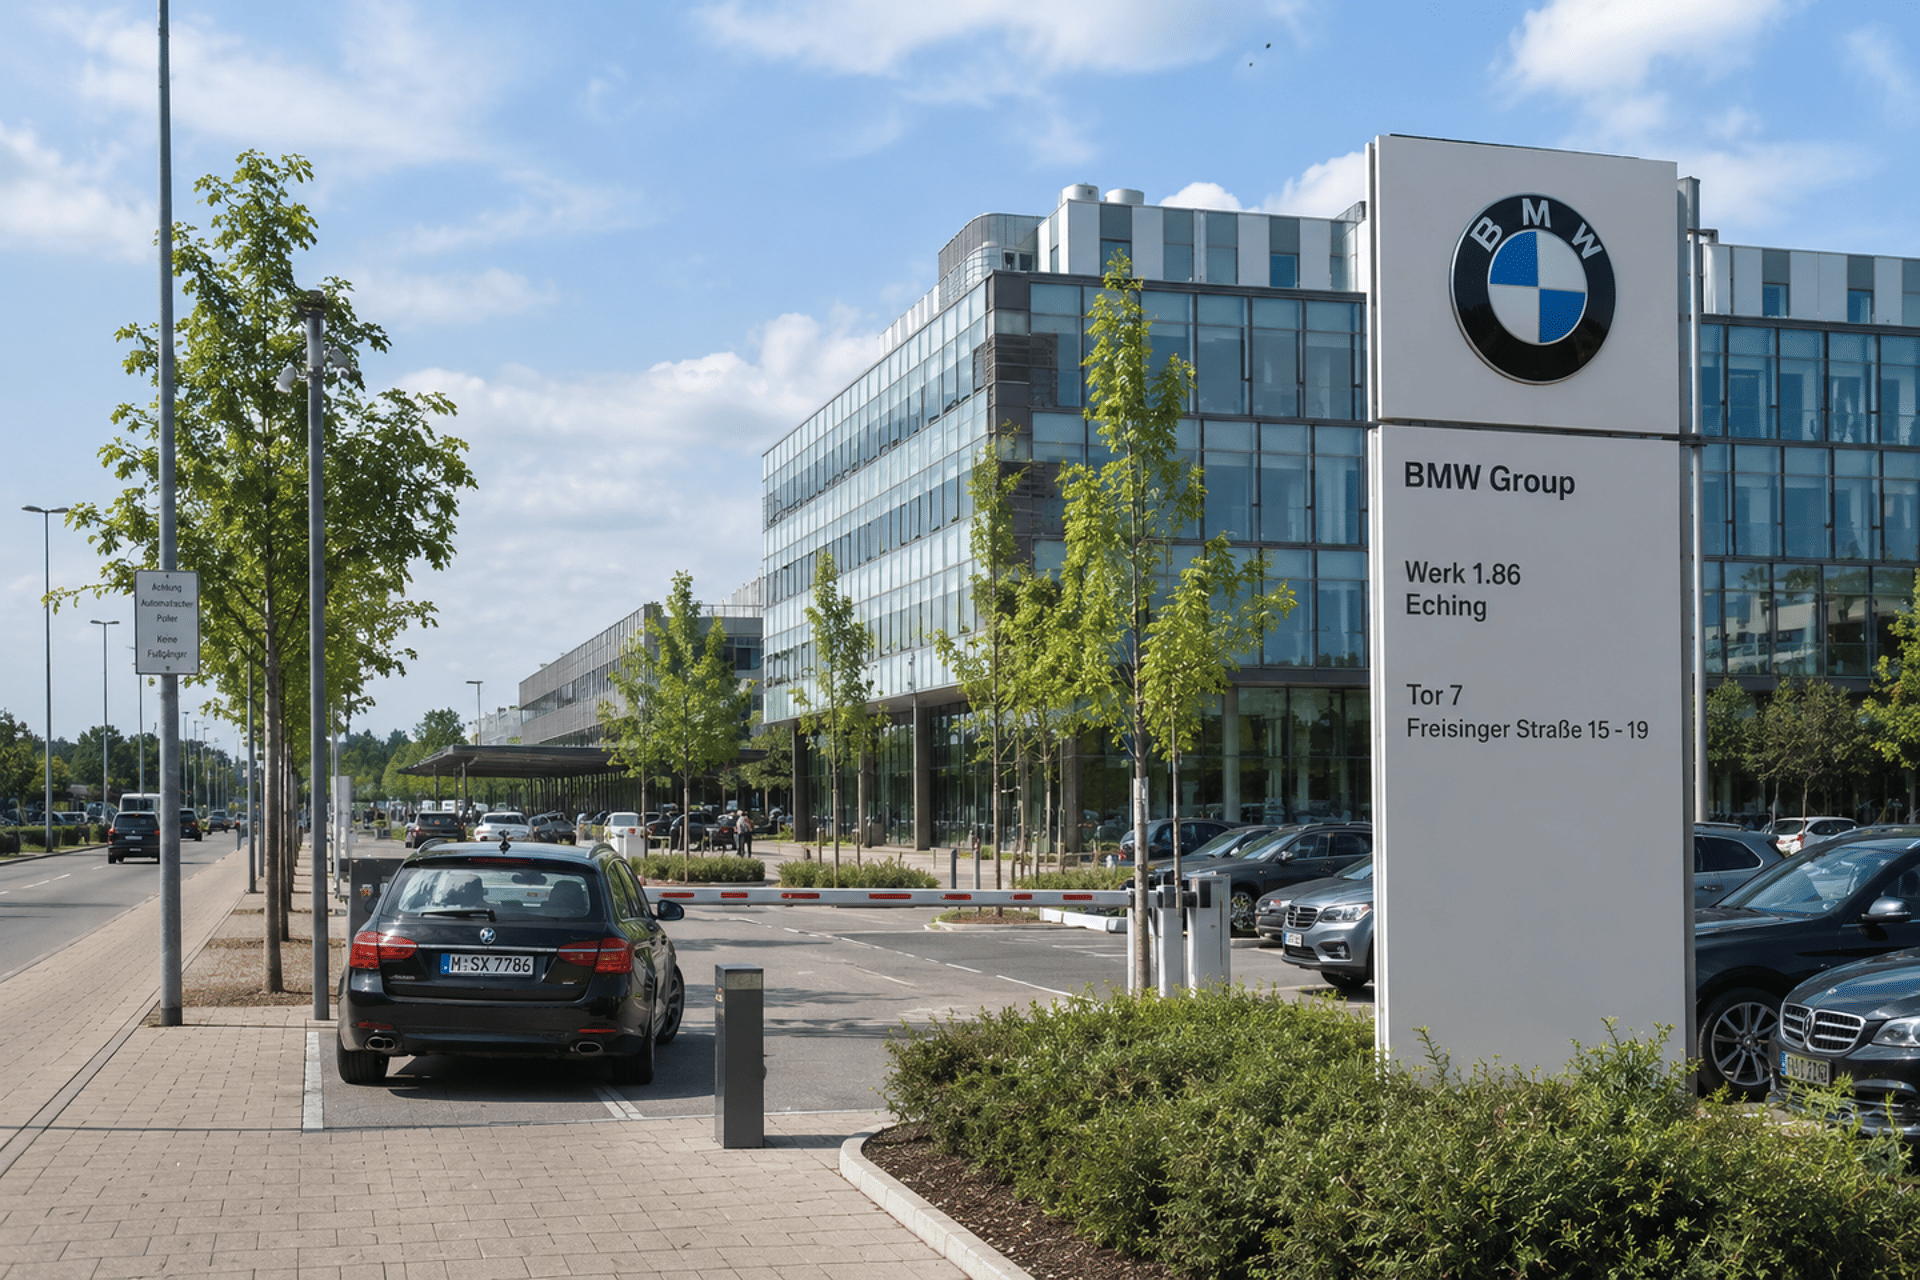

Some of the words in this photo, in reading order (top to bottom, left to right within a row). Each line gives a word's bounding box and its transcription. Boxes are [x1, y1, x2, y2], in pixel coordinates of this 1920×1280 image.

[1469, 198, 1604, 260] BMW
[1404, 461, 1482, 490] BMW
[1489, 465, 1576, 500] Group
[1405, 560, 1466, 584] Werk
[1472, 563, 1521, 585] 1.86
[1406, 593, 1487, 622] Eching
[1406, 684, 1444, 705] Tor
[1449, 685, 1463, 706] 7
[1407, 718, 1511, 743] Freisinger
[1516, 719, 1583, 740] Straße
[471, 956, 490, 972] SX
[494, 957, 531, 973] 7786
